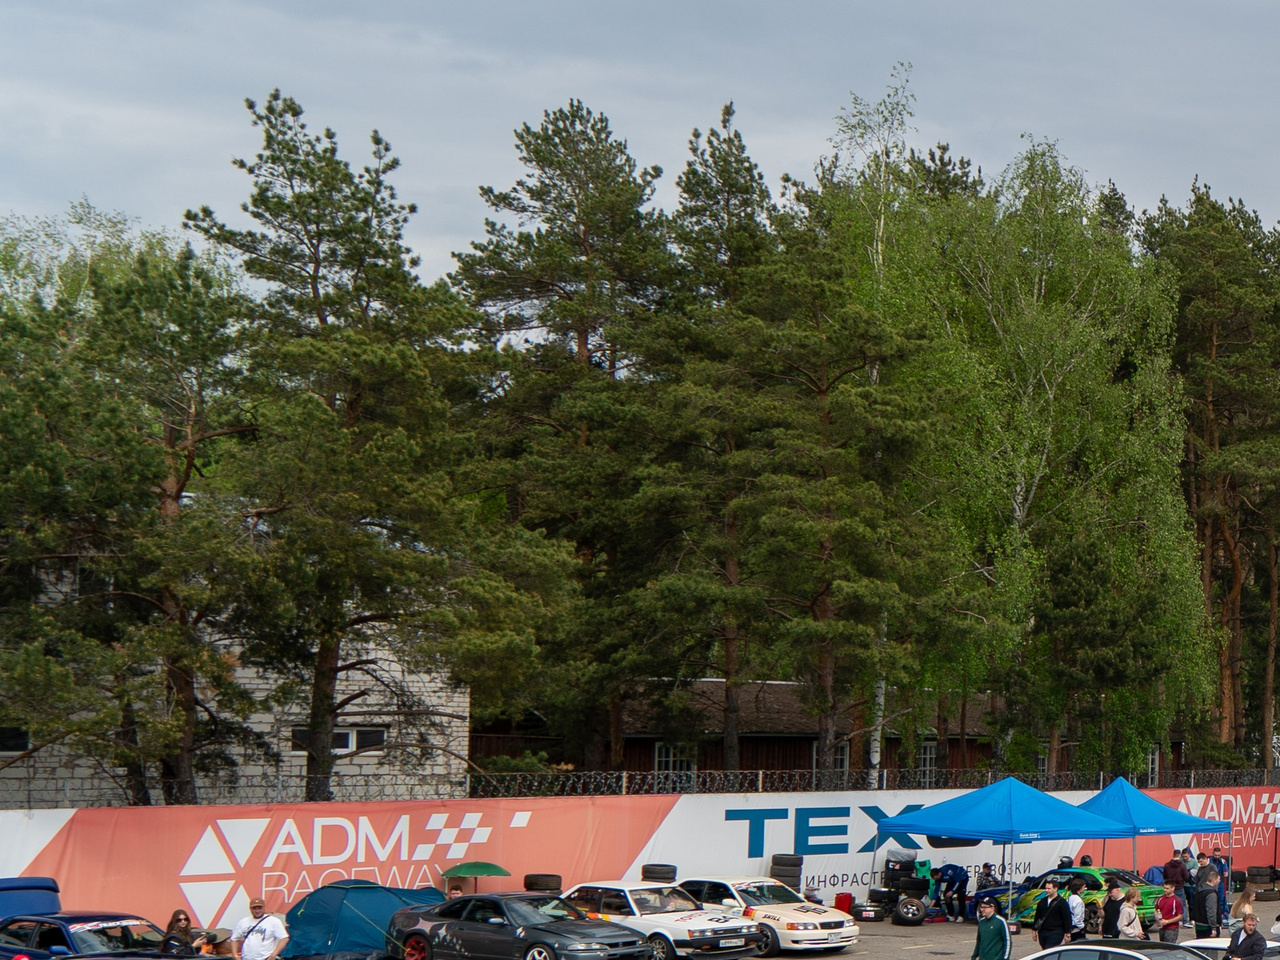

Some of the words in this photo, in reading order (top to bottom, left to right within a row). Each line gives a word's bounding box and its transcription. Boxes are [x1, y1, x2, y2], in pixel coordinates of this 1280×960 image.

[1204, 794, 1256, 825] ADM
[263, 815, 410, 868] ADM
[724, 804, 1032, 858] TEX
[1200, 826, 1273, 849] RACEWAY
